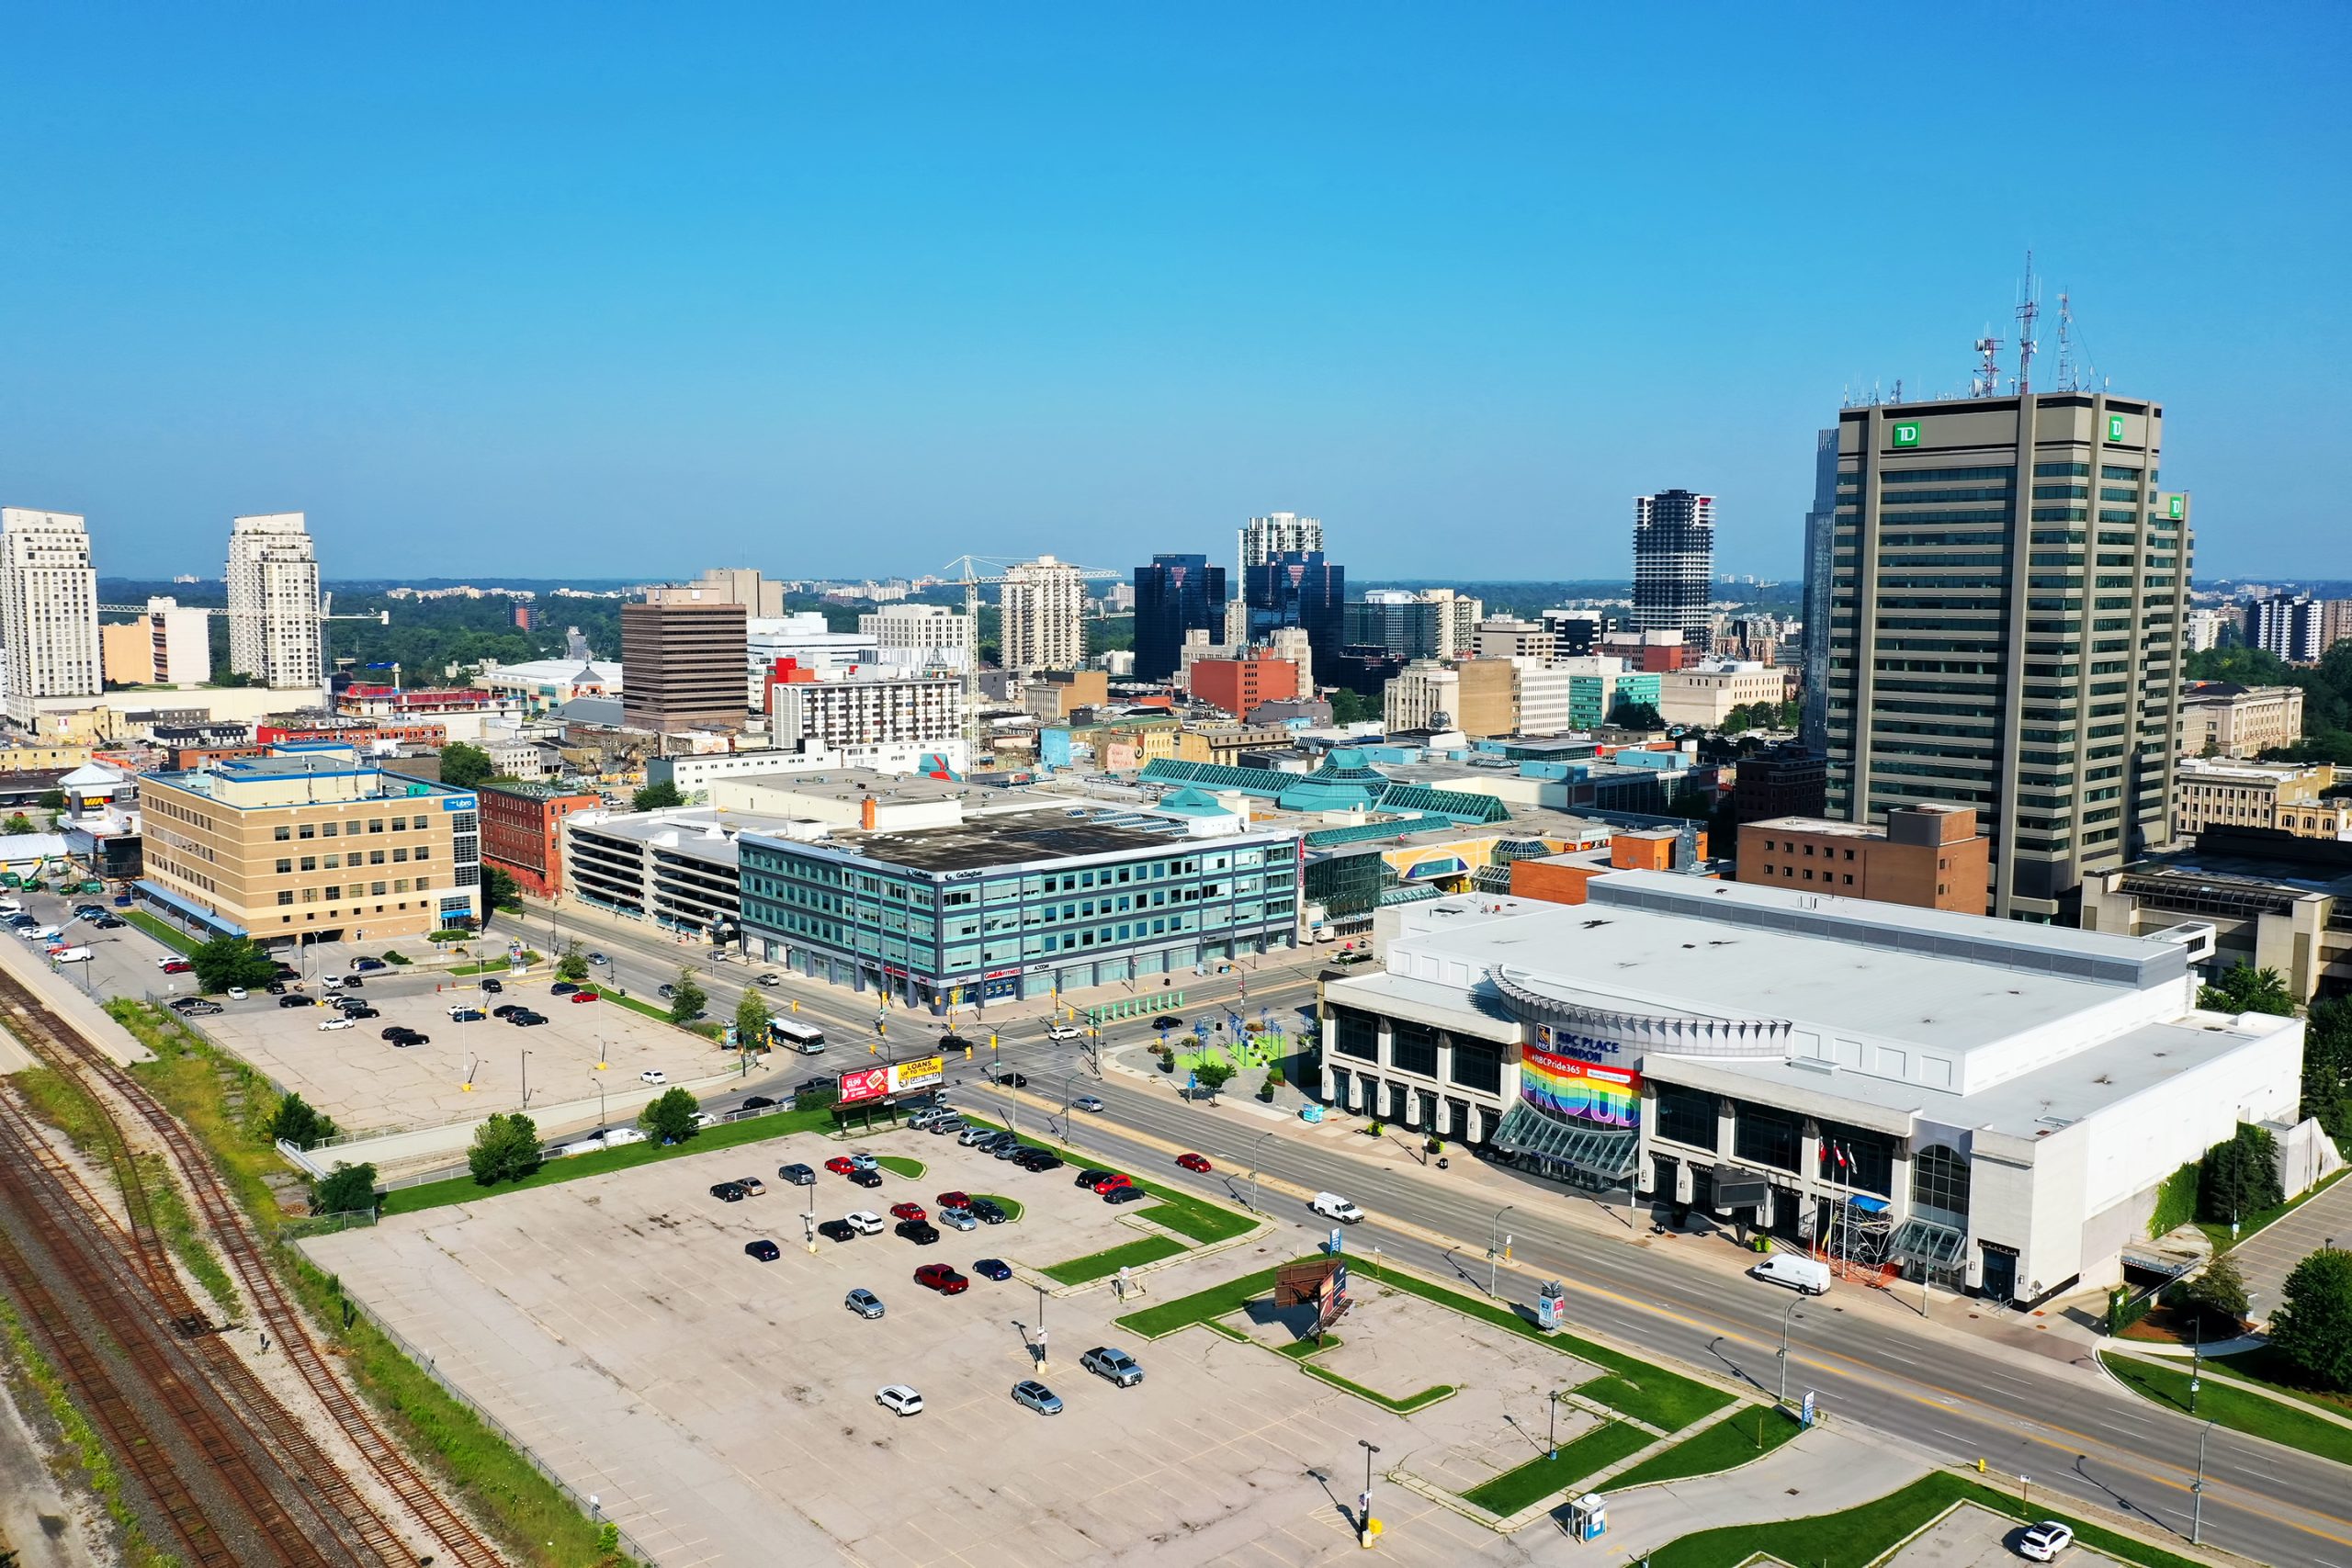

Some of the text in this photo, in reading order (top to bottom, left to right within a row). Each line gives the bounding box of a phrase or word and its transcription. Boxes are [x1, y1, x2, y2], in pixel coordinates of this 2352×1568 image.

[1897, 426, 1917, 441] TD
[2112, 421, 2121, 436] TD
[2172, 501, 2180, 513] TD
[84, 796, 104, 806] VIA
[1556, 1032, 1620, 1054] RBC PLACE
[1557, 1043, 1602, 1063] LONDON
[907, 1060, 932, 1071] LOANS
[1532, 1053, 1580, 1075] #RBCPride365
